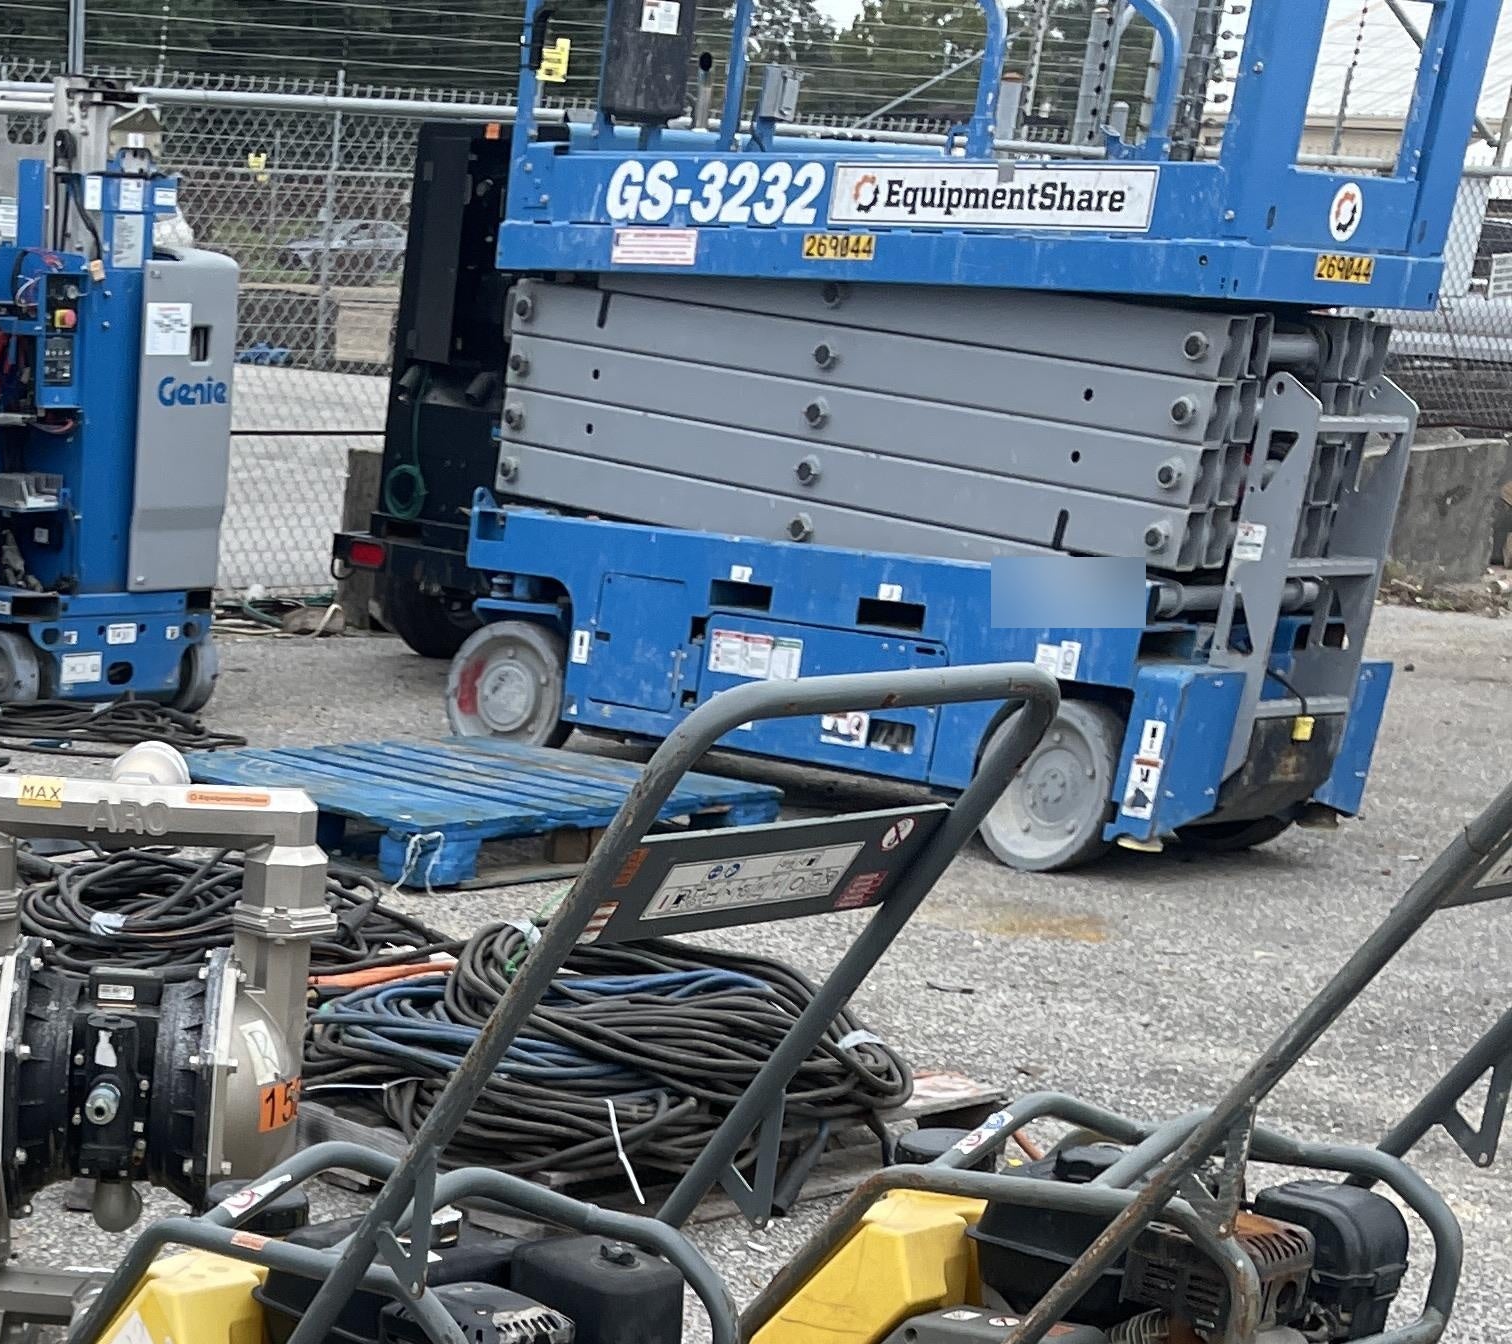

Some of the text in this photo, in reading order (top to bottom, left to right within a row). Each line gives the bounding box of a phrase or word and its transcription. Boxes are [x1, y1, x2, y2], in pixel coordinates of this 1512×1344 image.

[605, 160, 826, 225] GS-3232
[883, 178, 1125, 214] EquipmentShare
[804, 235, 873, 259] 269044
[158, 376, 228, 406] Genie
[21, 784, 62, 801] MAX
[88, 799, 172, 836] ARO
